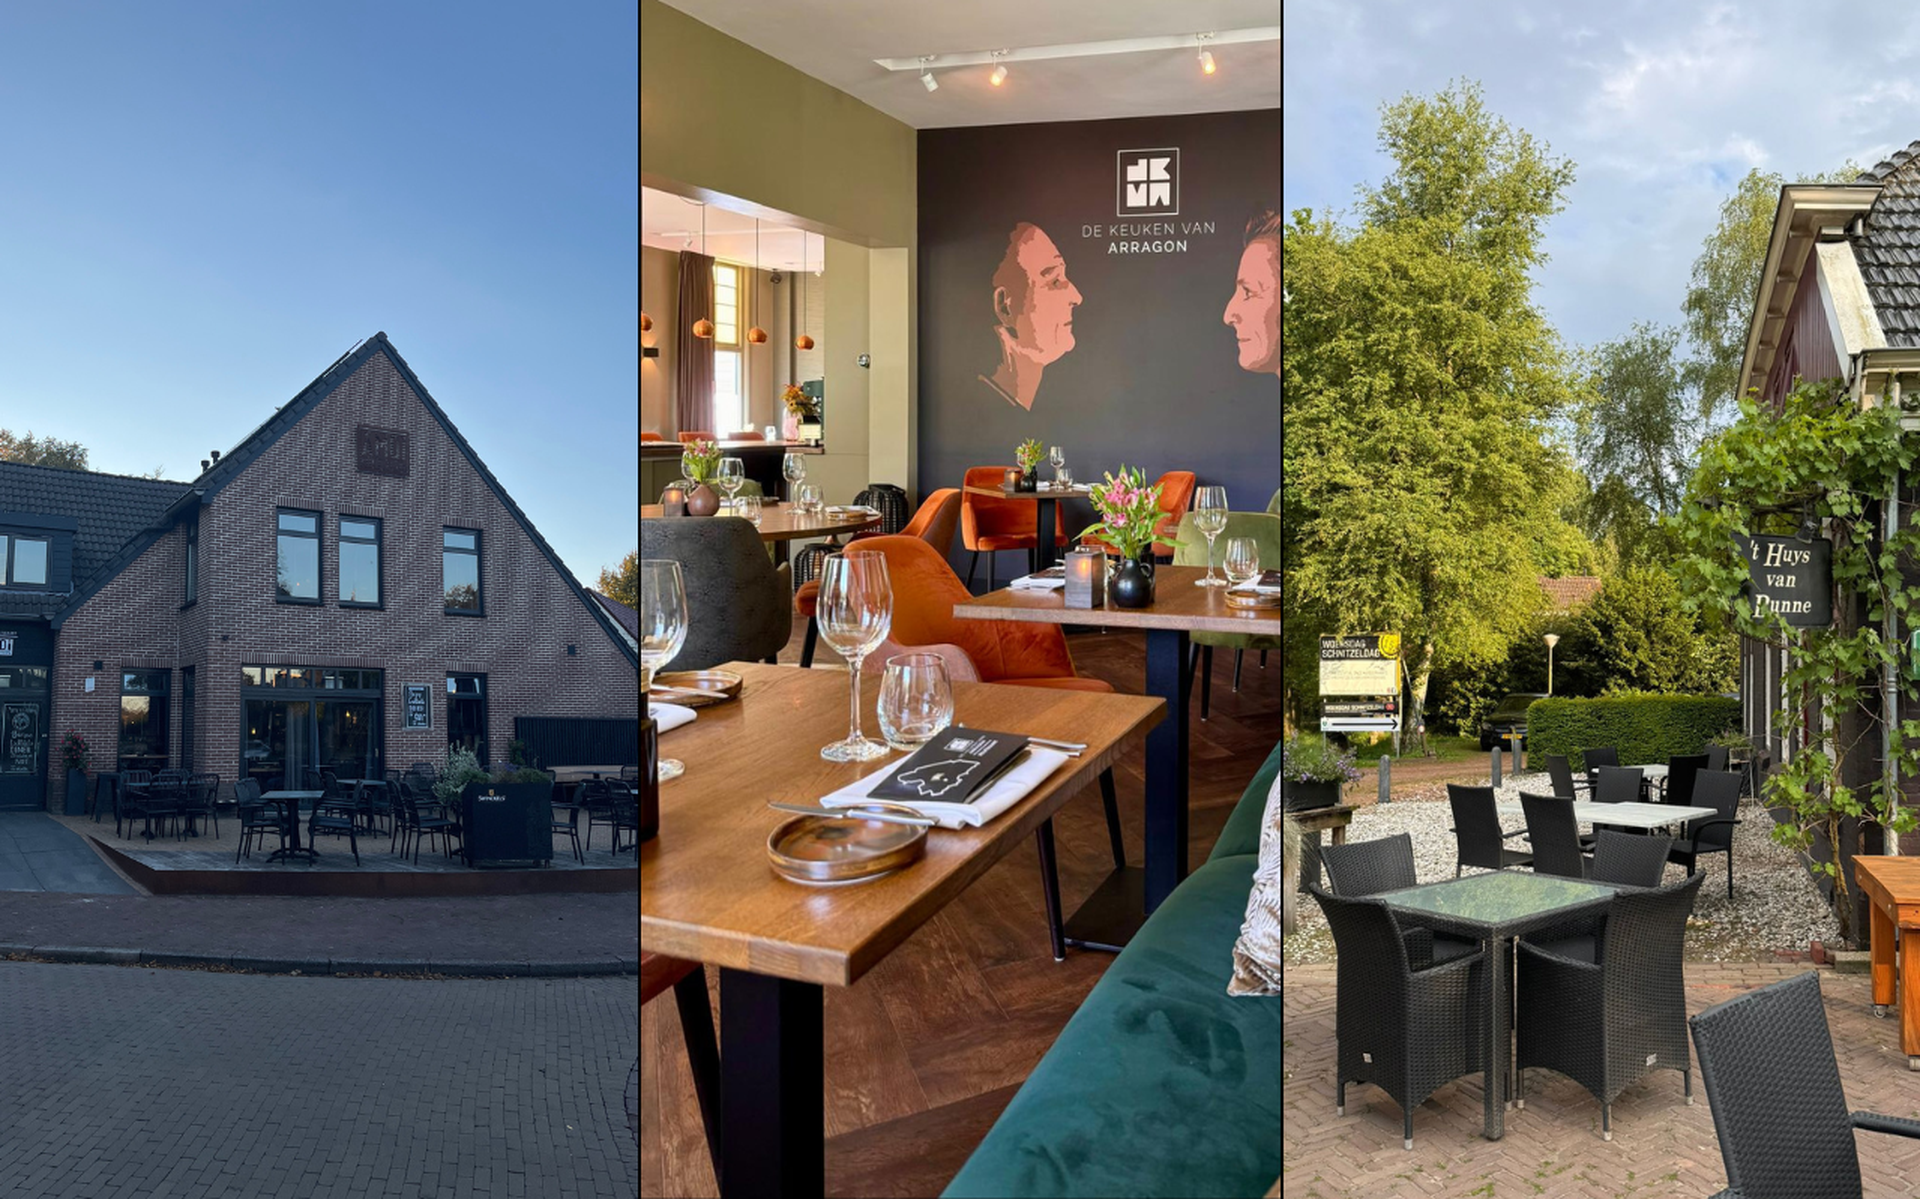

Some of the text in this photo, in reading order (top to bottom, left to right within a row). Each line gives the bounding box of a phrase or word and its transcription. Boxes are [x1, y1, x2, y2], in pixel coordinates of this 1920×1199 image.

[1082, 222, 1216, 238] DE KEUKEN VAN
[1108, 240, 1188, 254] ARRAGON
[1749, 539, 1812, 567] 't Huys
[1766, 574, 1796, 588] van
[1322, 649, 1380, 658] SCHNITZELDAG
